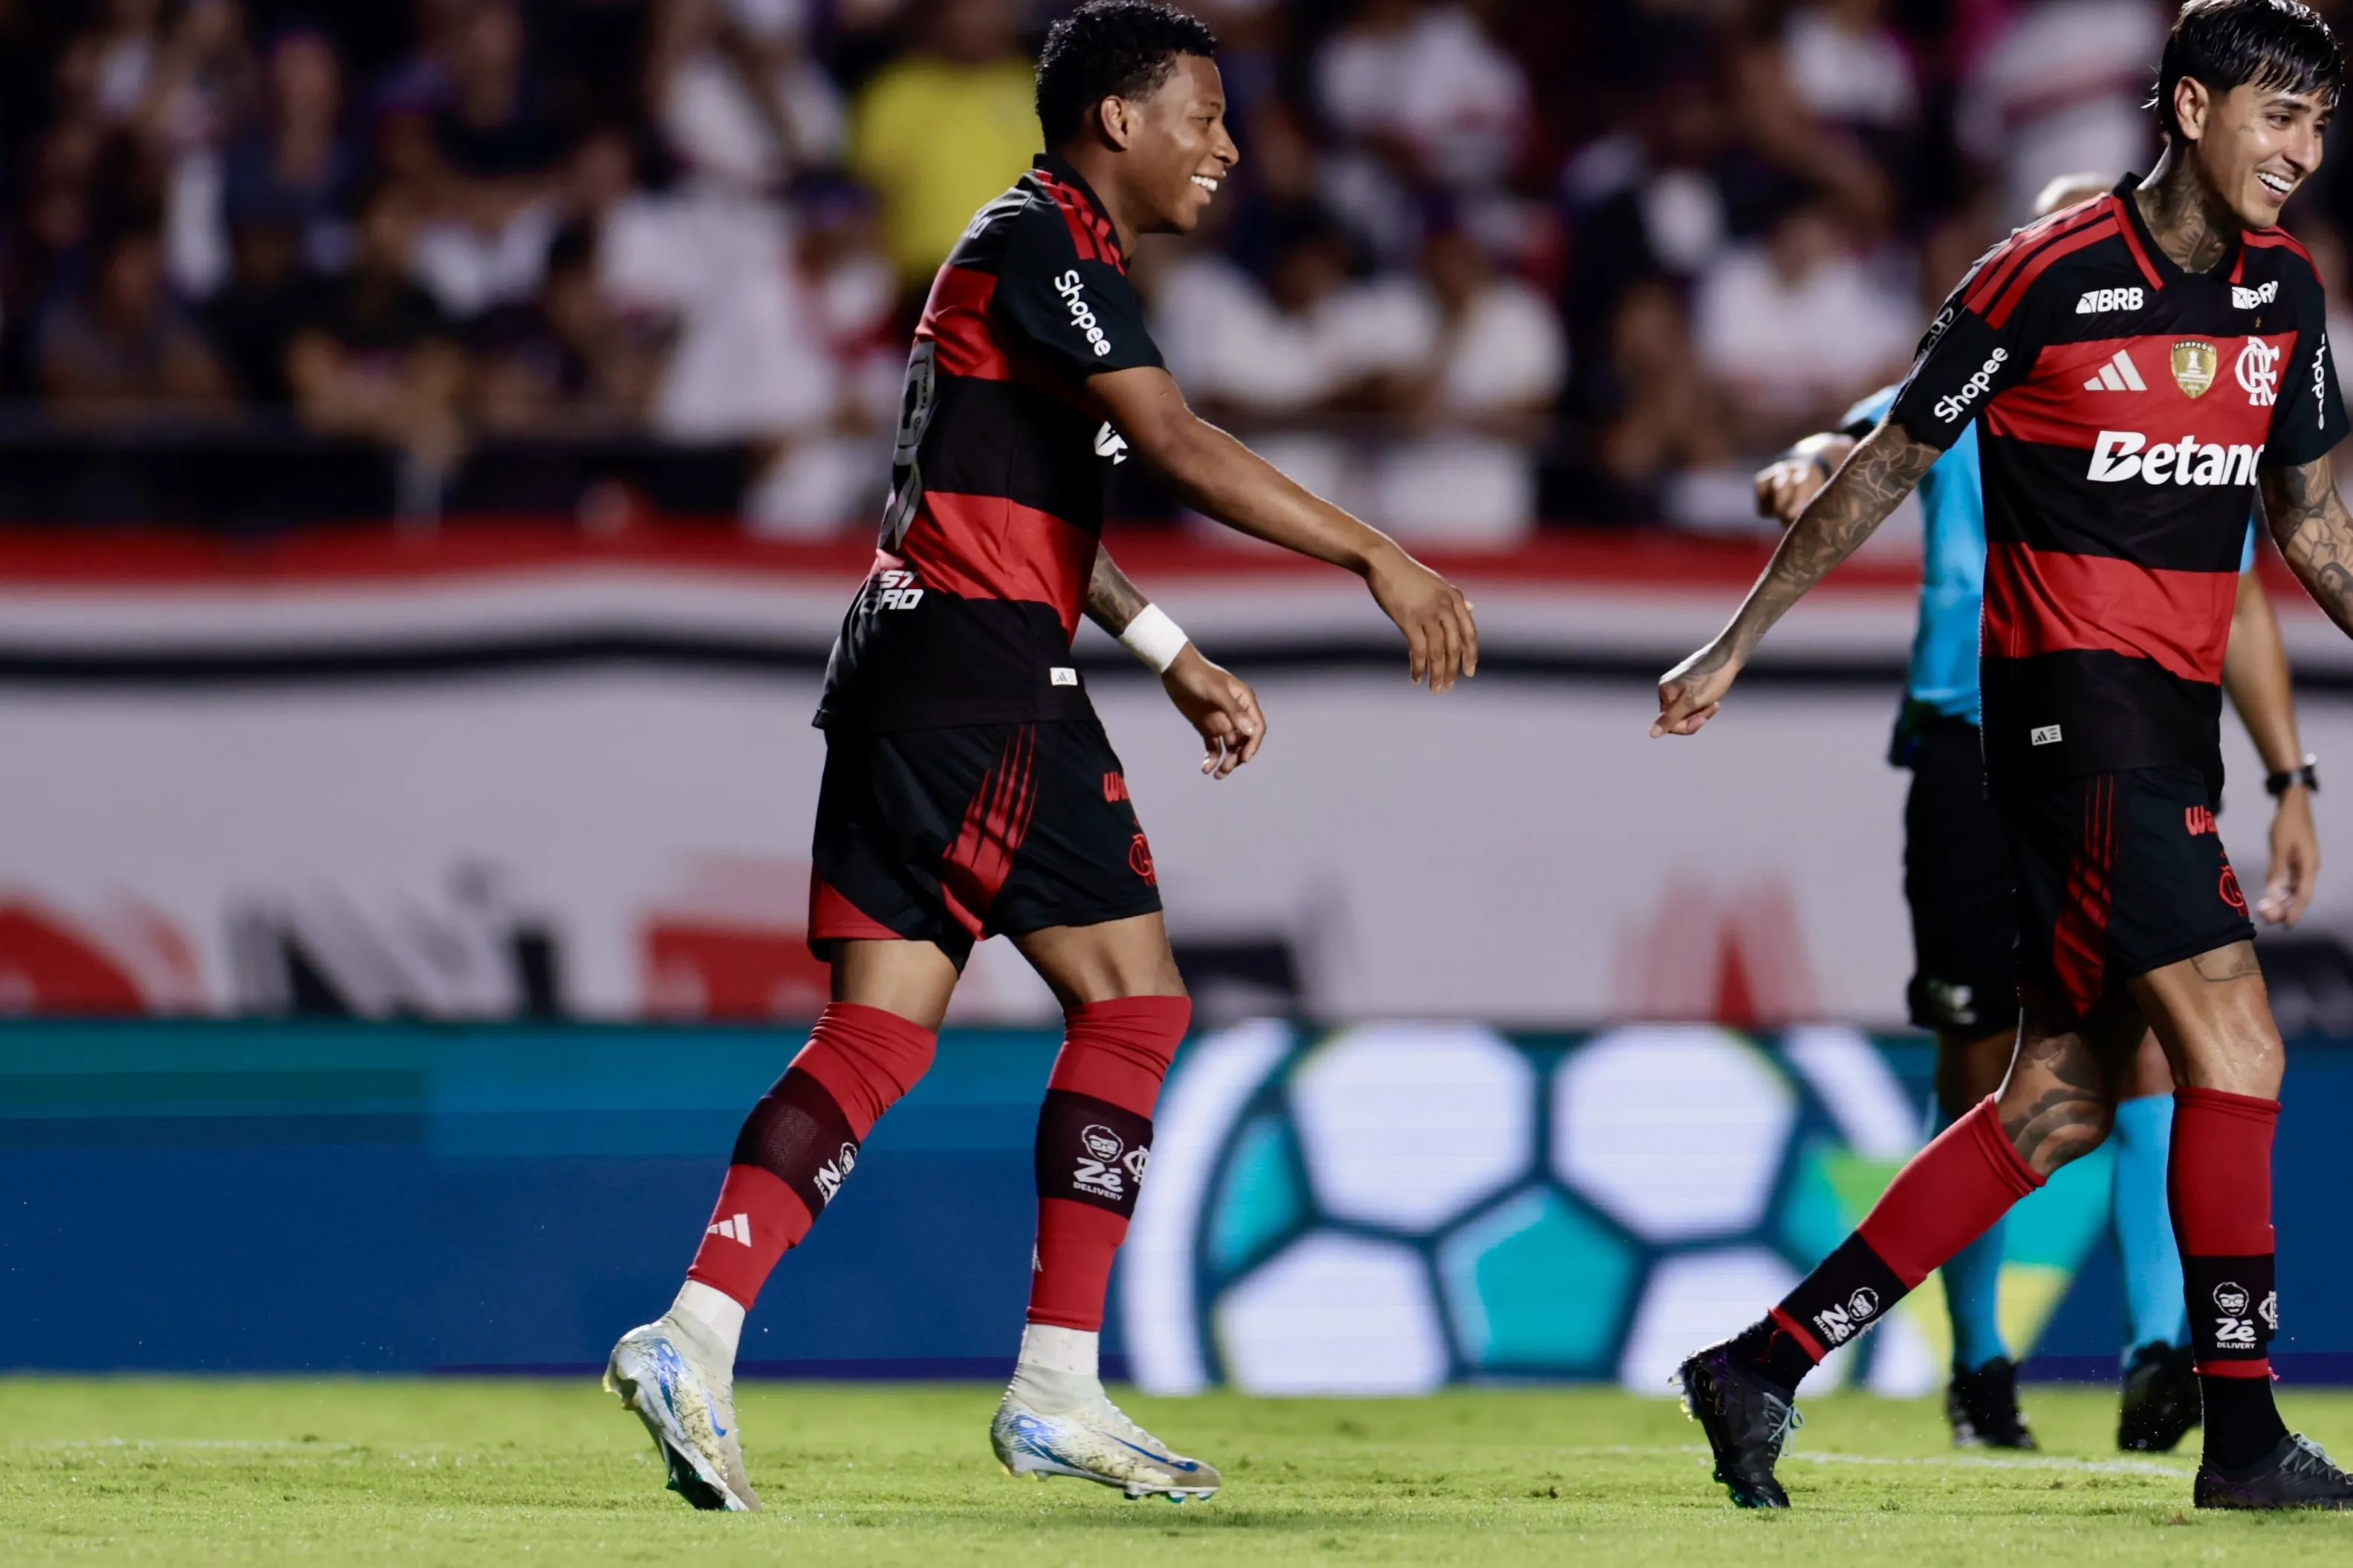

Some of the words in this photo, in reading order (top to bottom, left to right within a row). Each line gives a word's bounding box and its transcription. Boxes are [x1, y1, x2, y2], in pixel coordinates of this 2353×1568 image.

[2097, 287, 2143, 312] BRB
[1055, 270, 1111, 357] Shopee
[1934, 347, 2008, 423] Shopee
[1073, 1181, 1123, 1201] DELIVERY
[2216, 1341, 2256, 1350] DELIVERY
